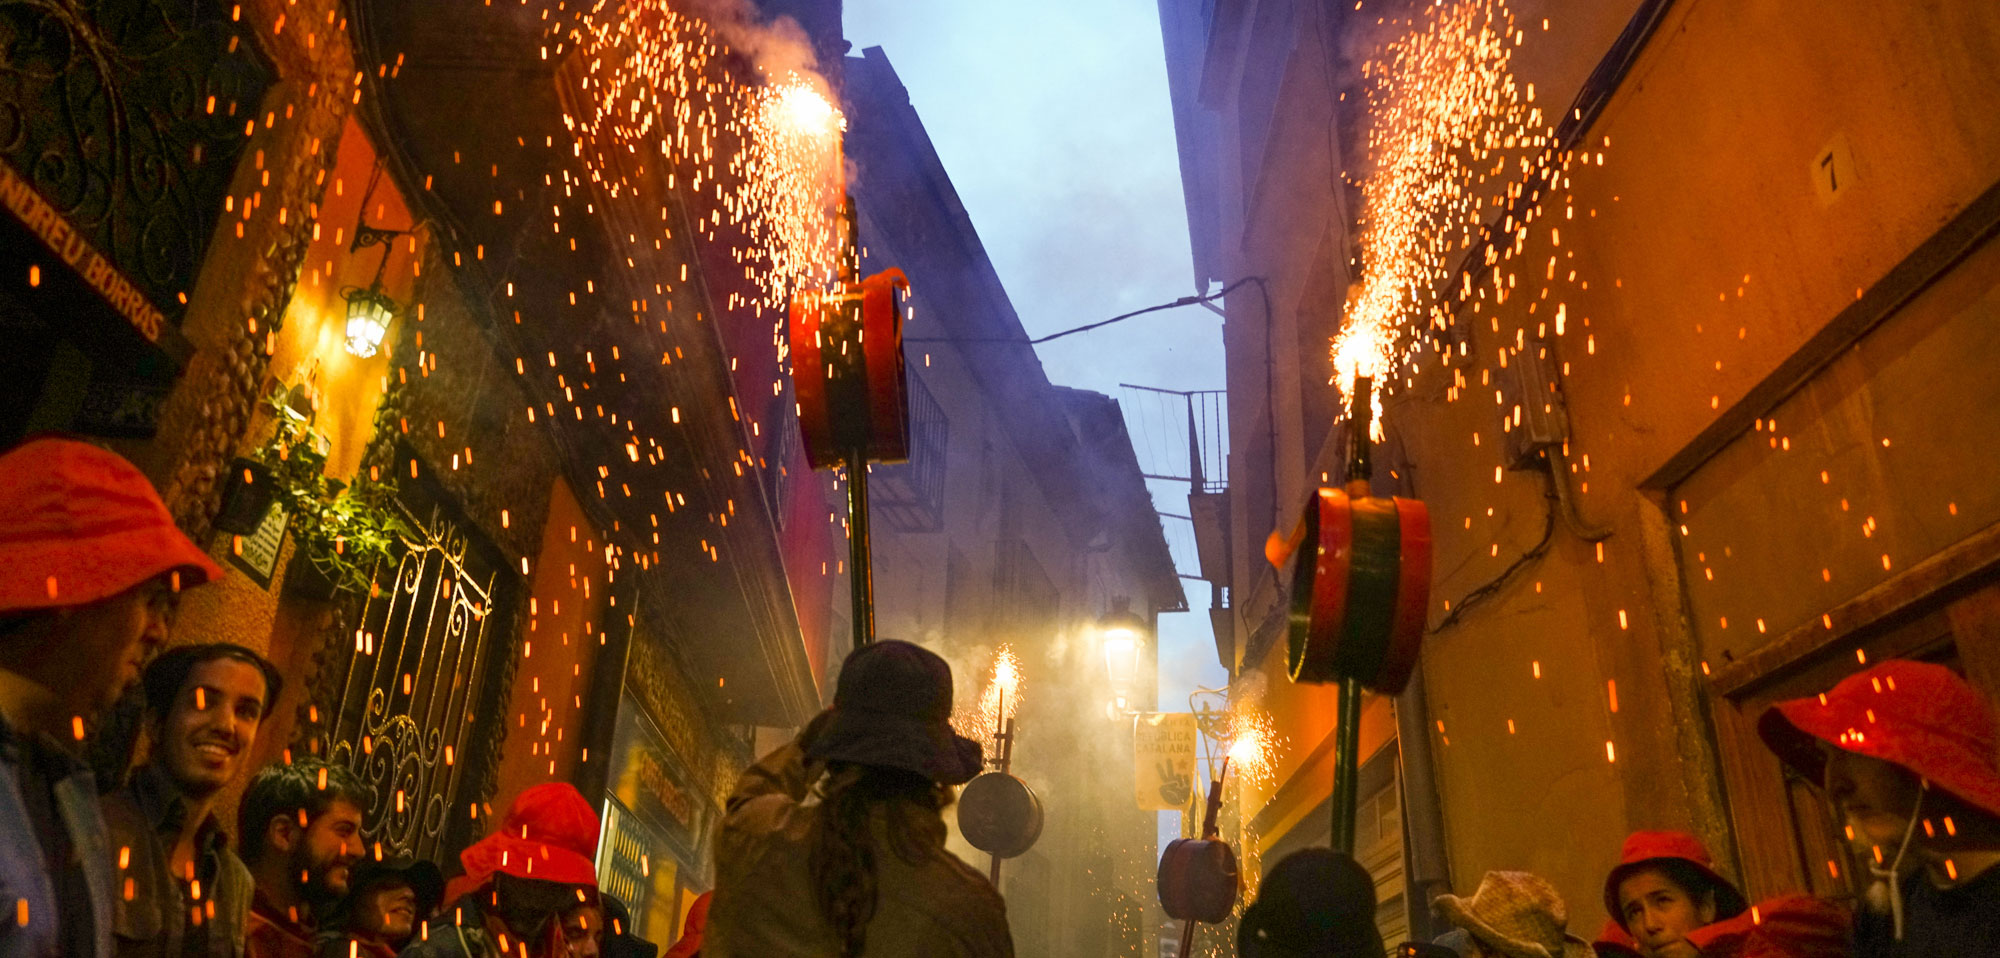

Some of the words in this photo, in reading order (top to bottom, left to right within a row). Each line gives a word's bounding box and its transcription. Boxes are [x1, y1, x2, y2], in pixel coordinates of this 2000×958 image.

[1821, 151, 1838, 192] 7
[0, 157, 86, 266] NDREU
[83, 252, 164, 342] BORRAS
